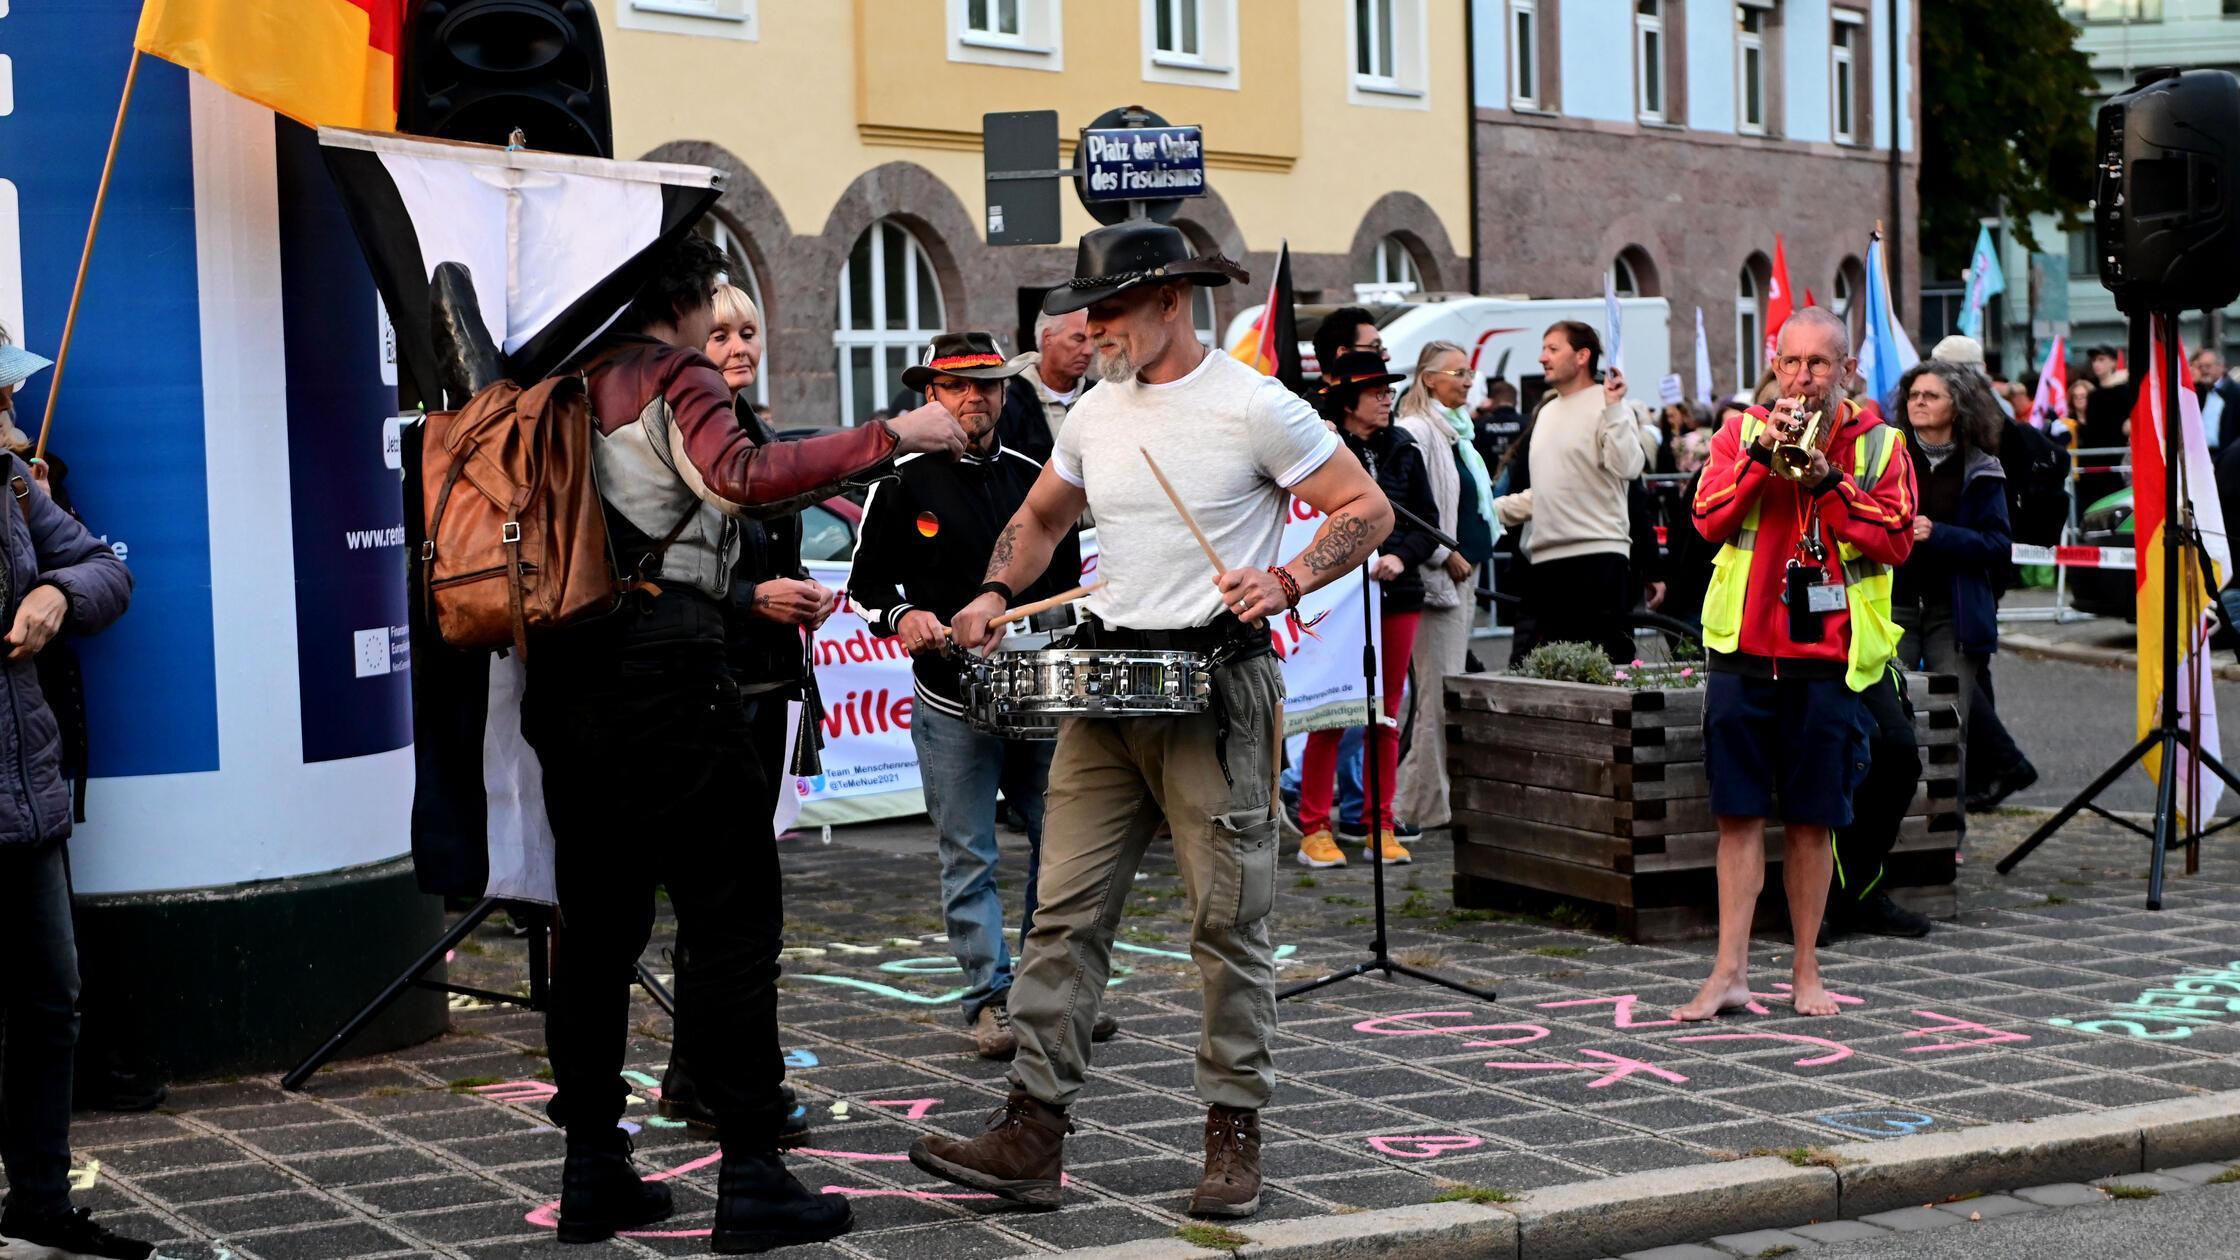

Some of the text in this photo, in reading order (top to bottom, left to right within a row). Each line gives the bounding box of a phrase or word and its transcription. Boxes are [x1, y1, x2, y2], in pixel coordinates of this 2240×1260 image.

[1088, 132, 1199, 163] Platz der Opfer
[1091, 162, 1202, 190] des Faschismus
